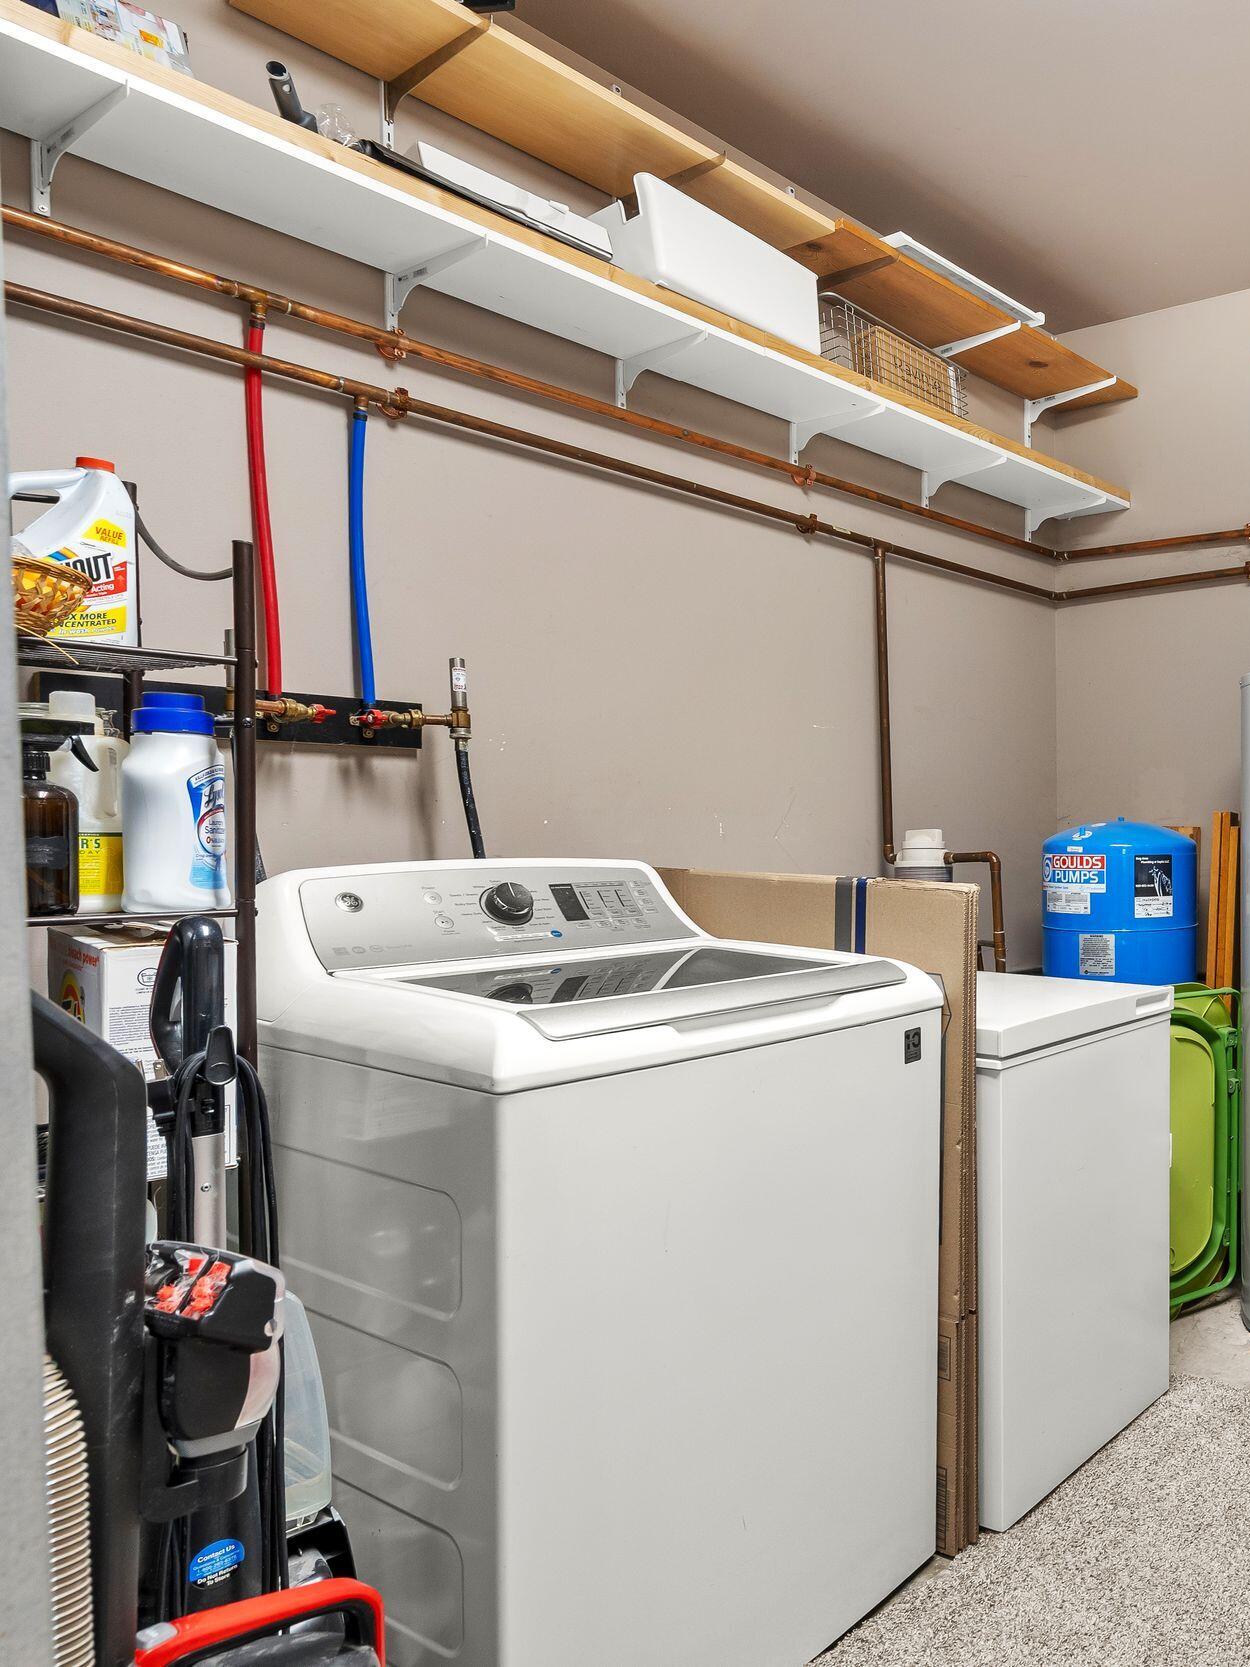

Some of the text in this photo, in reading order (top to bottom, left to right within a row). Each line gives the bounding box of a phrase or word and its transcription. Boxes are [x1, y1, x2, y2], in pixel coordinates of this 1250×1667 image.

[95, 526, 123, 541] VALUE
[91, 583, 115, 593] Acting
[79, 612, 108, 620] MORE
[1053, 856, 1103, 869] GOULDS
[1055, 871, 1099, 883] PUMPS
[197, 1544, 236, 1563] Contact Us
[214, 1572, 231, 1583] Store
